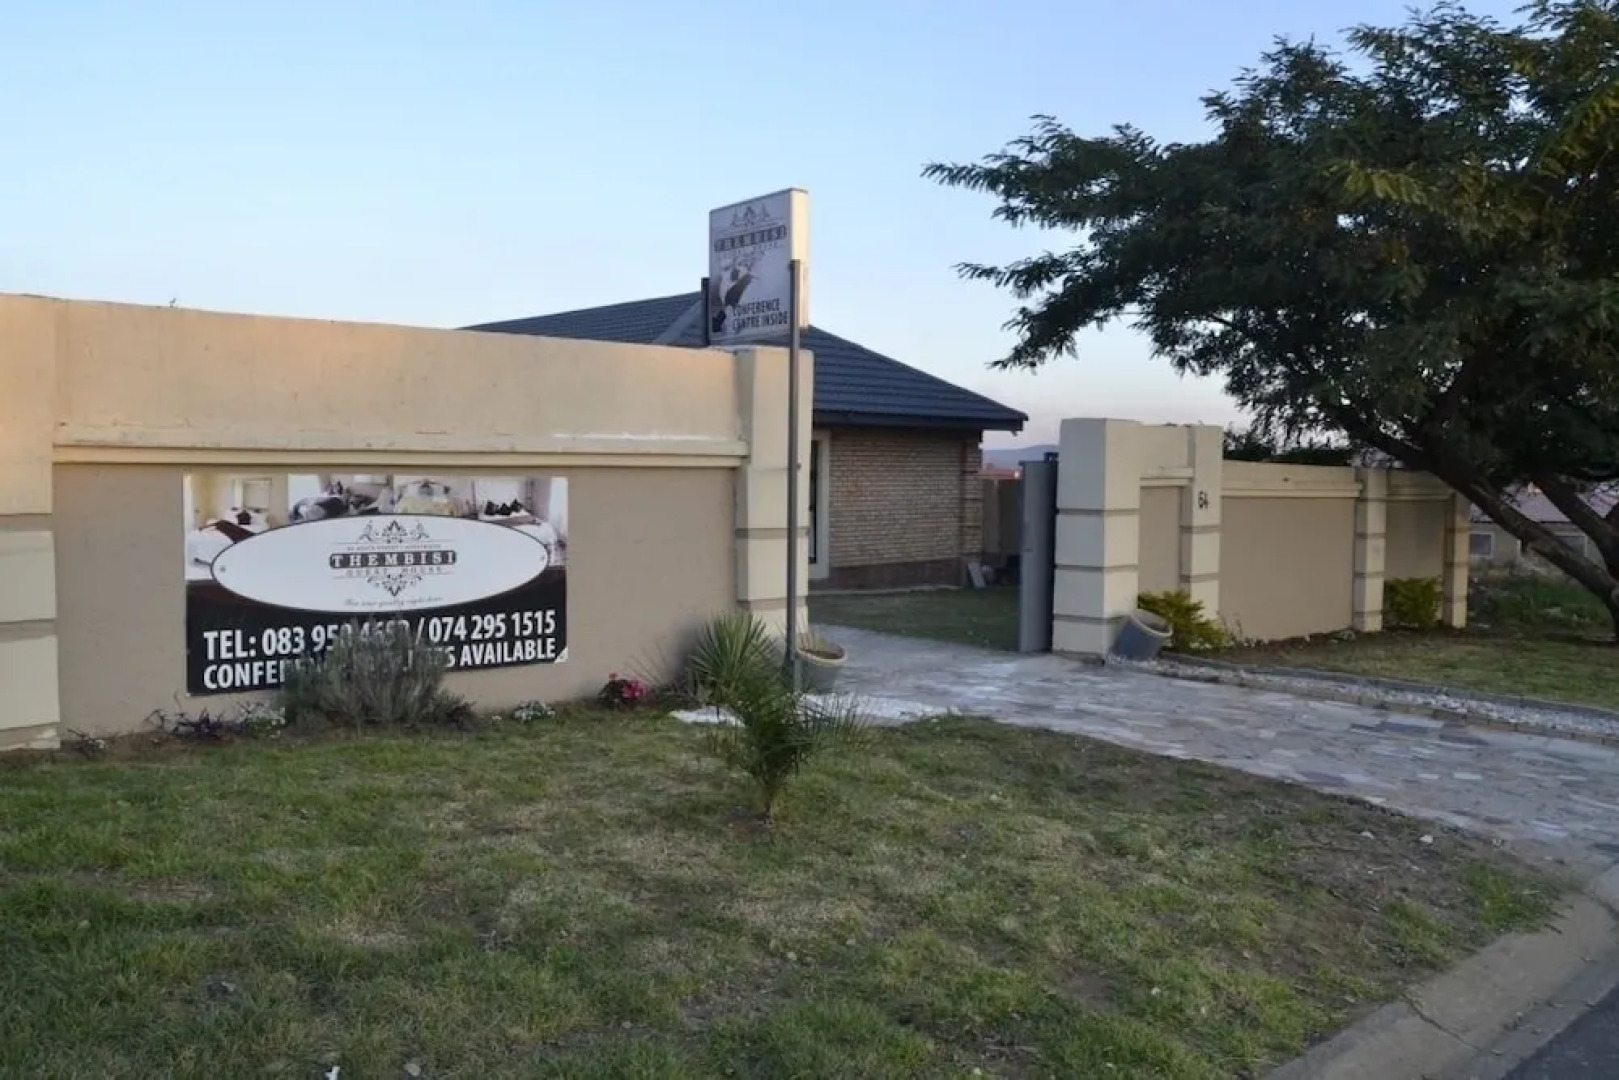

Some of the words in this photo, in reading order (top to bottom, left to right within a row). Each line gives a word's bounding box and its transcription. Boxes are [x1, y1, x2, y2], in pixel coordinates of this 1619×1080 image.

[331, 549, 454, 568] THEMBISI
[203, 629, 257, 660] TEL:
[261, 626, 305, 656] 083
[428, 616, 467, 643] 074
[470, 613, 506, 640] 295
[511, 609, 556, 637] 1515
[459, 637, 556, 666] AVAILABLE
